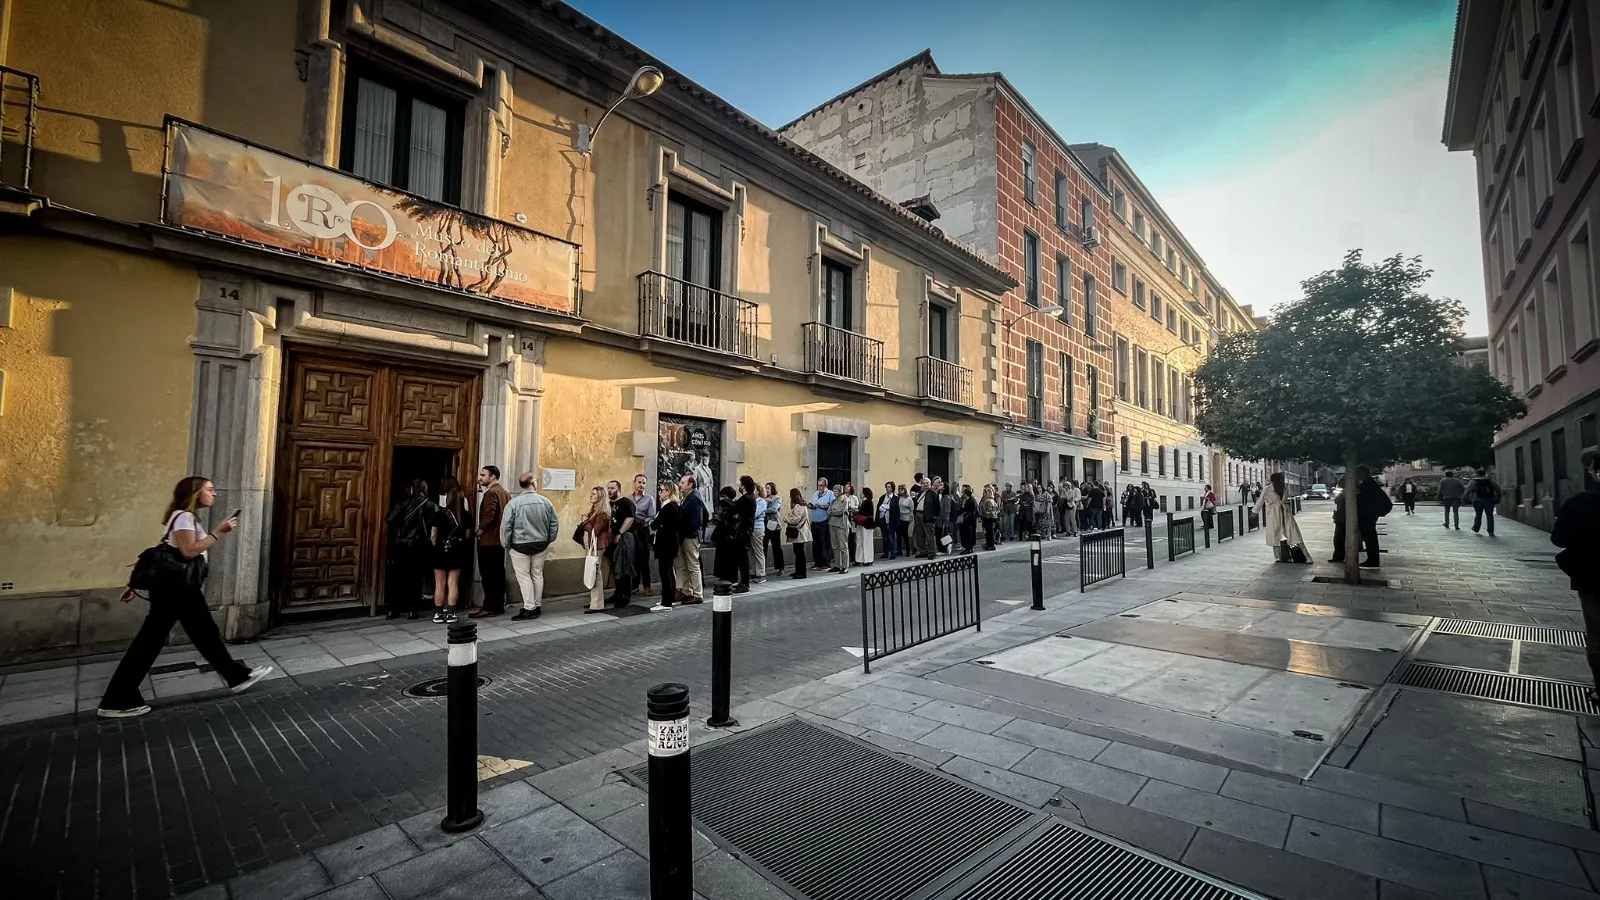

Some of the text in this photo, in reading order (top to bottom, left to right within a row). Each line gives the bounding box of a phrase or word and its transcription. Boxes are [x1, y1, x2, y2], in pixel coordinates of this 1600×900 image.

[415, 223, 501, 257] Museo del
[415, 241, 528, 282] Romanticismo
[219, 287, 240, 300] 14
[521, 341, 534, 351] 14
